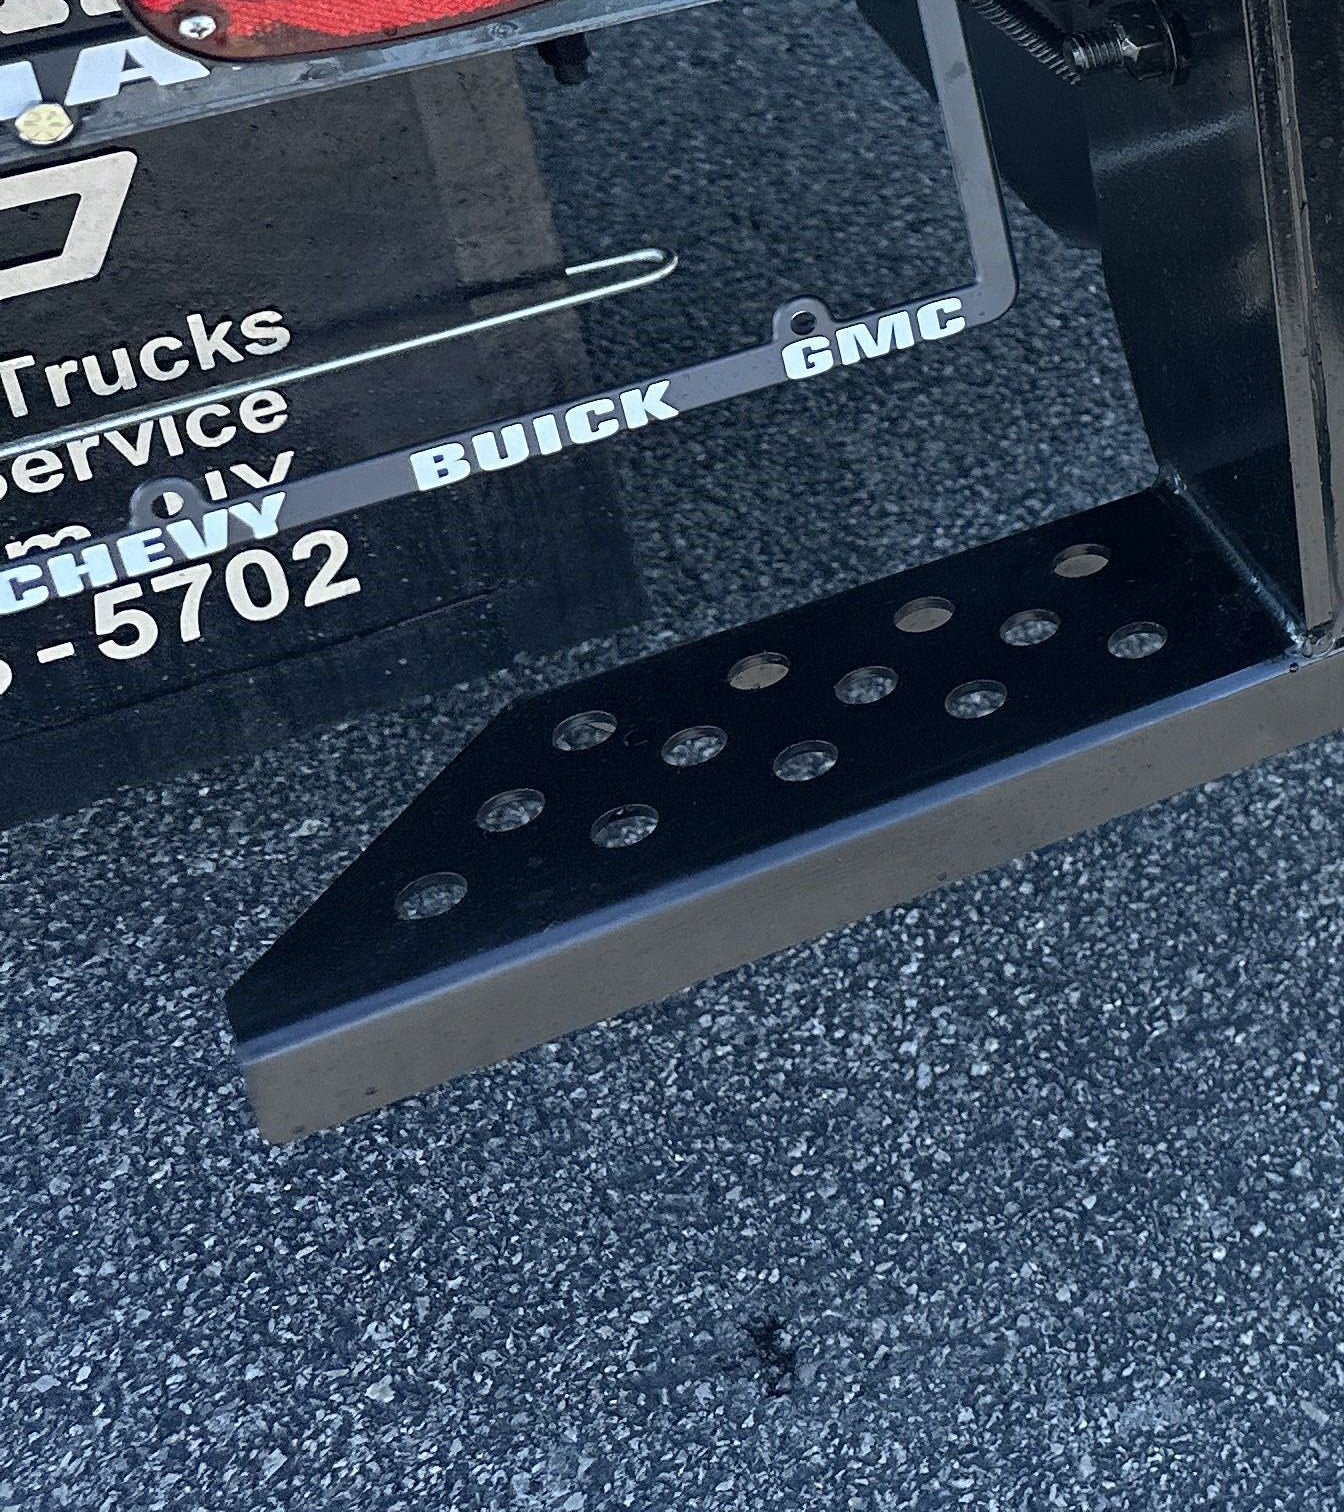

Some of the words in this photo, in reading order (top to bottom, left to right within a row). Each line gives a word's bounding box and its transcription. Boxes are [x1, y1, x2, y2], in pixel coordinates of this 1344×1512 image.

[0, 310, 291, 418] Trucks
[0, 389, 289, 501] ervice
[0, 491, 287, 615] CHEVY
[409, 380, 680, 492] BUICK
[781, 296, 967, 380] GMC
[0, 529, 361, 694] -5702
